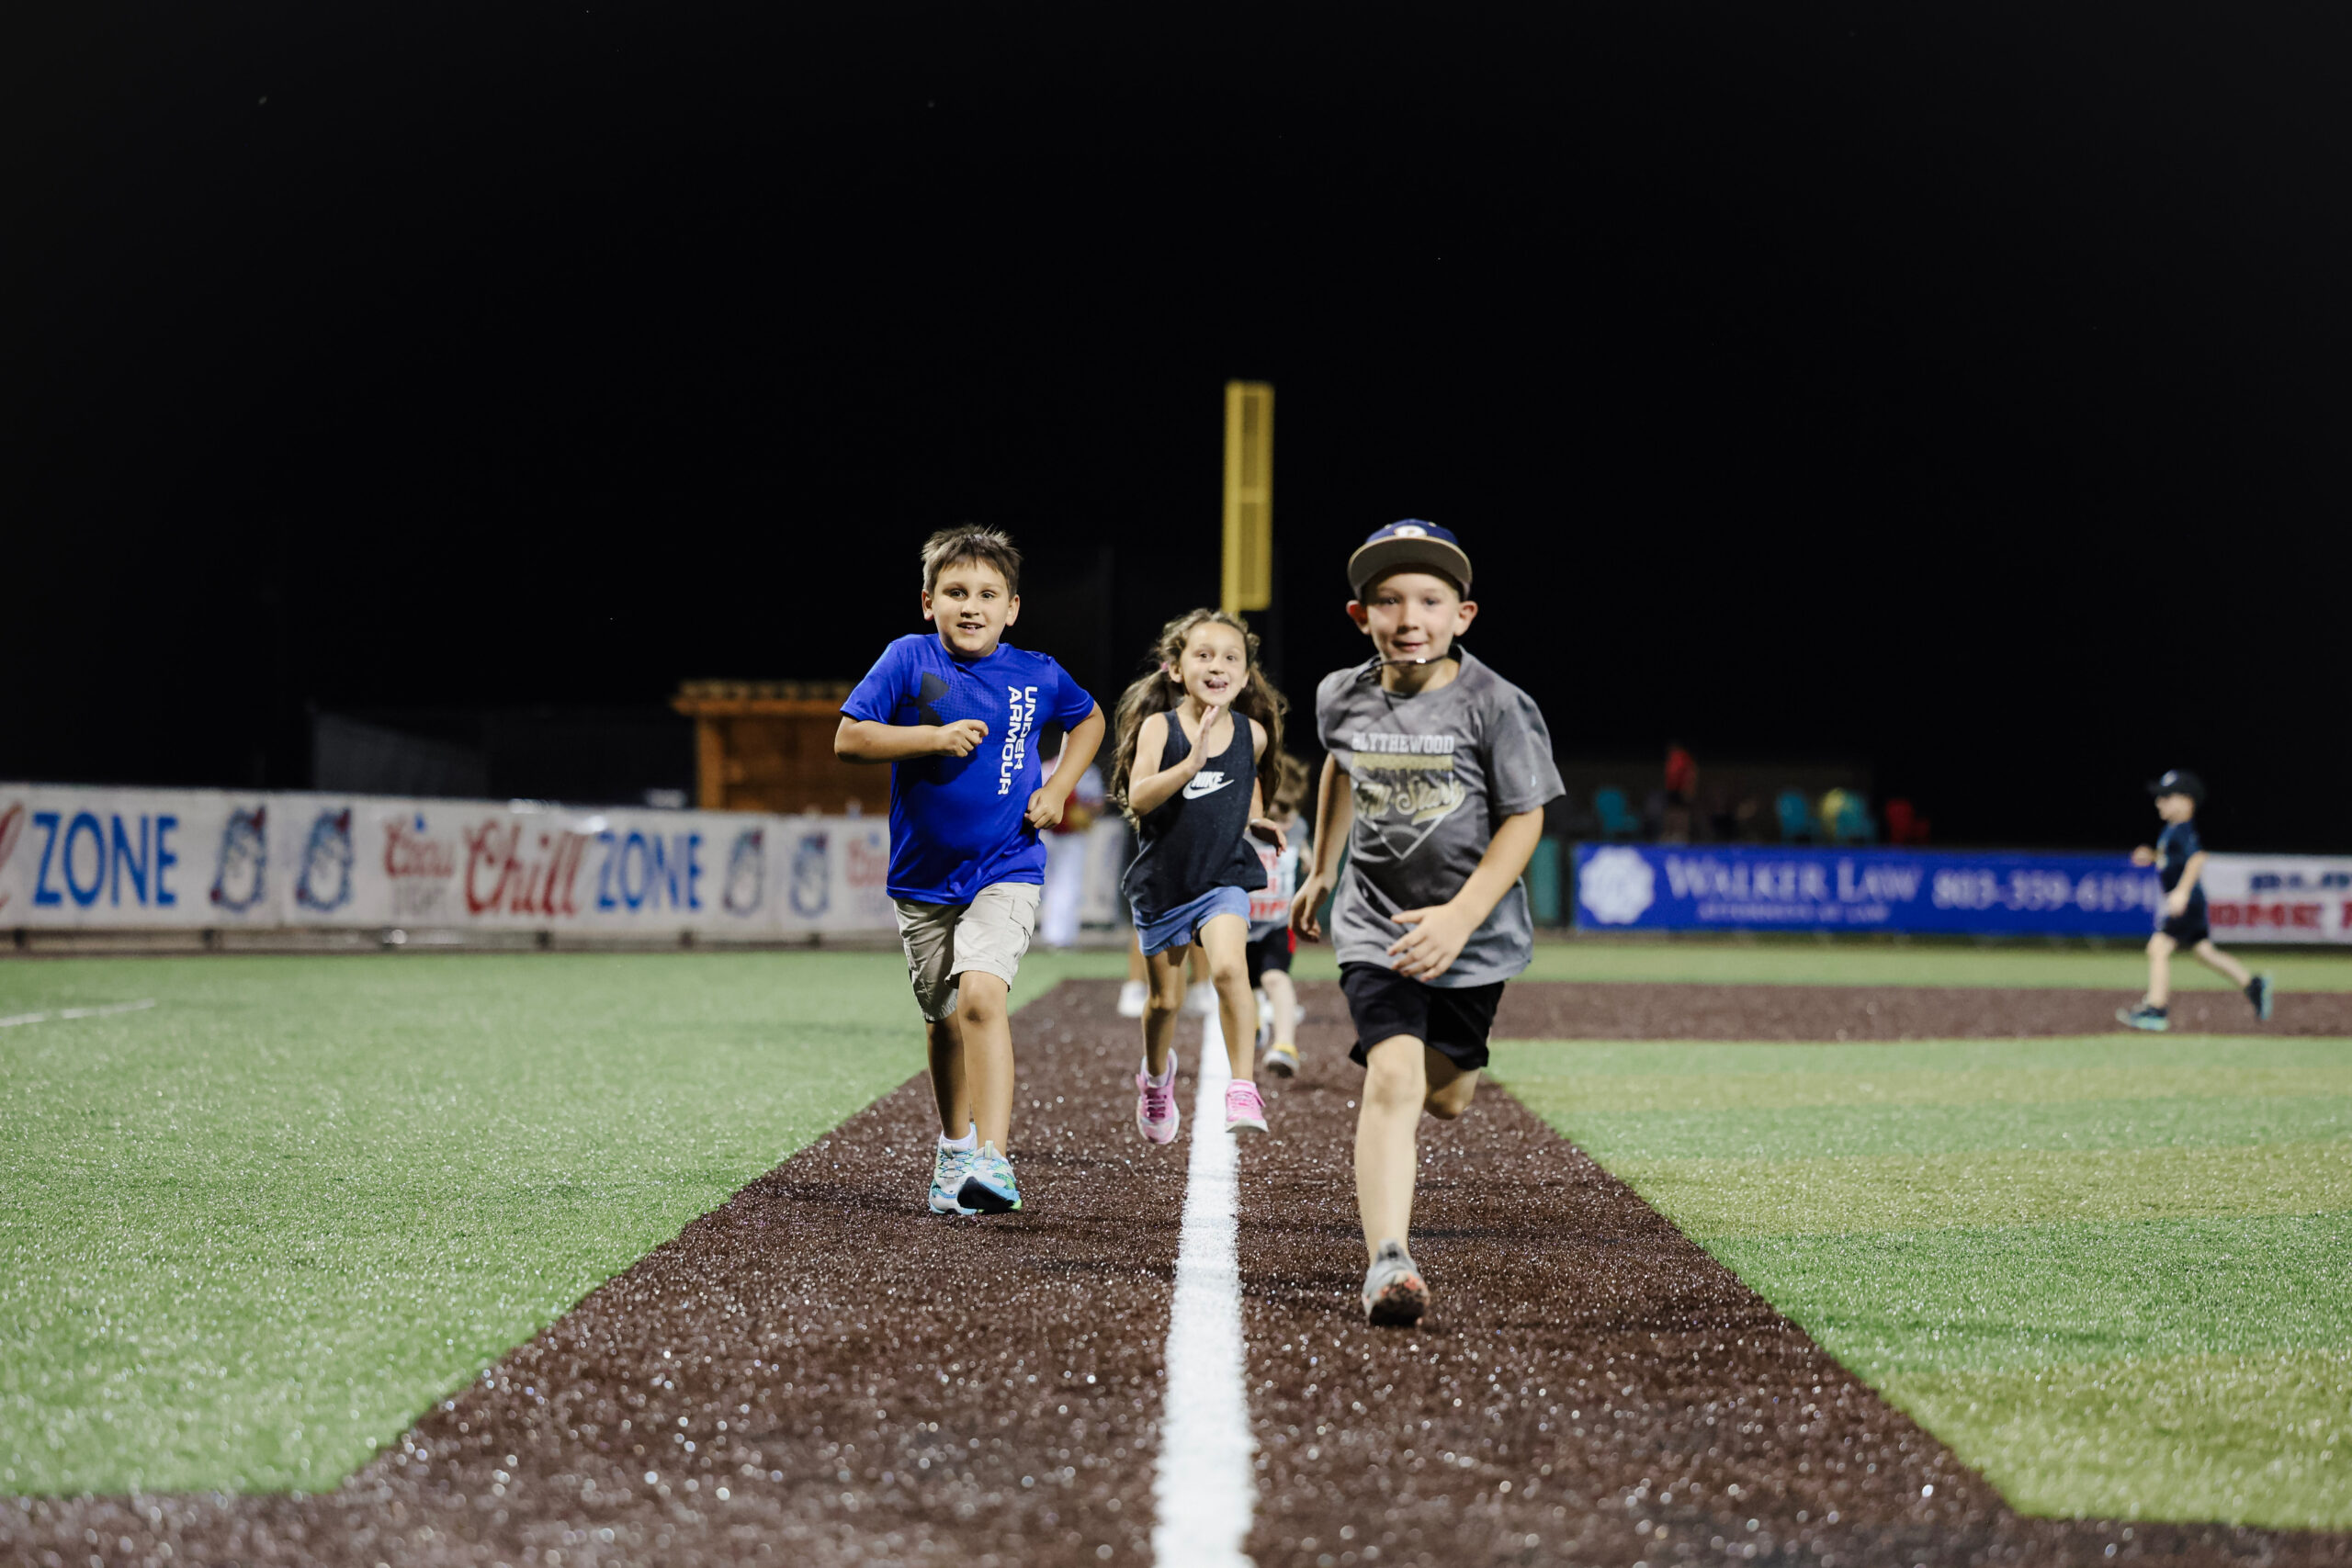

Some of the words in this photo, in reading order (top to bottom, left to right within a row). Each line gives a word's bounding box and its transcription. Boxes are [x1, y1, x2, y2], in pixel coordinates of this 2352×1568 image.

[998, 685, 1023, 795] ARMOUR
[1013, 685, 1038, 770] UNDER
[1351, 732, 1454, 754] BLYTHEWOOD
[1191, 771, 1225, 788] NIKE
[32, 808, 179, 909] ZONE
[465, 820, 594, 917] Chill
[594, 832, 702, 913] ZONE
[1665, 855, 1828, 902] WALKER
[1838, 858, 1924, 905] LAW
